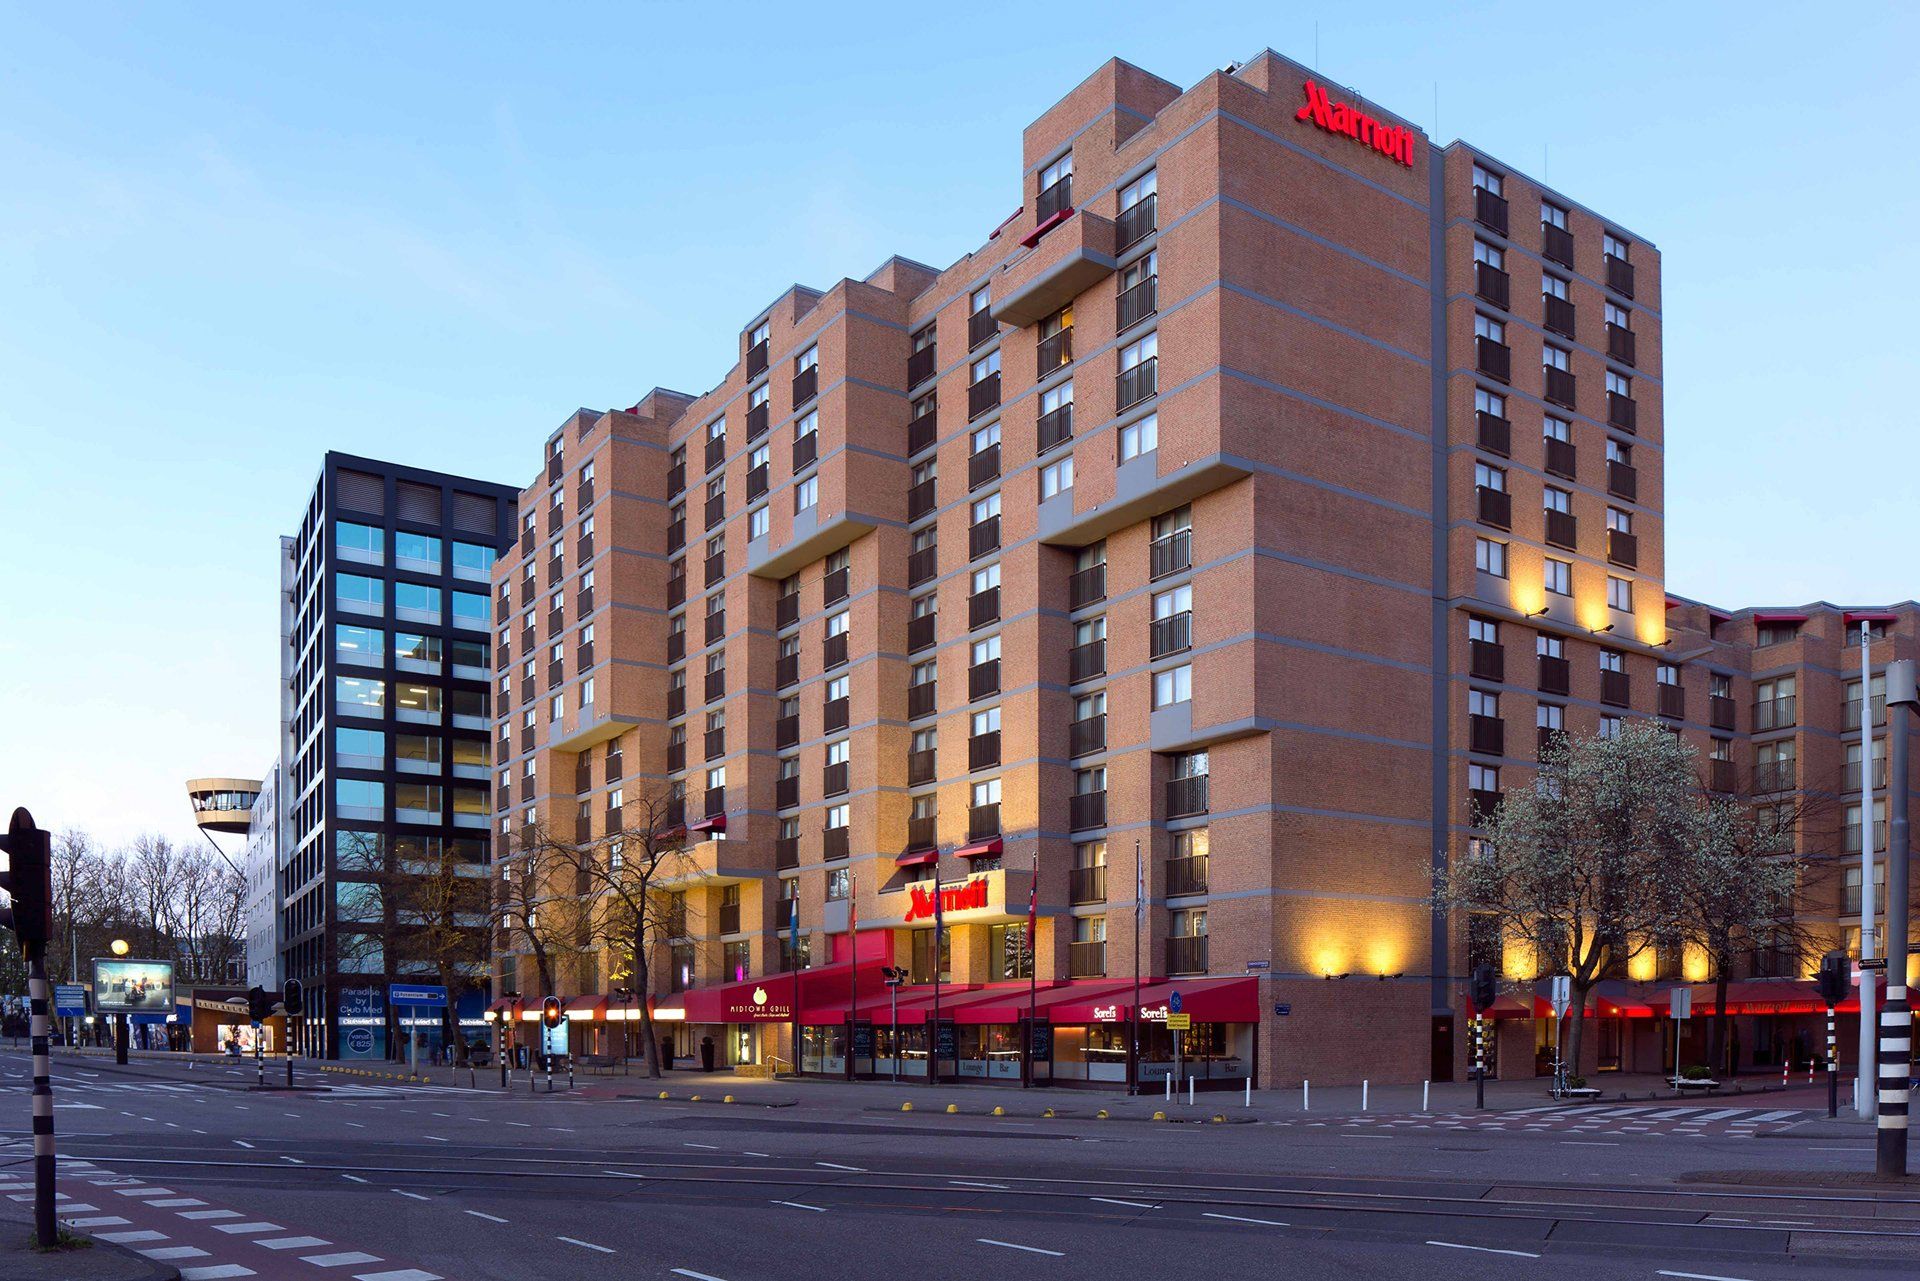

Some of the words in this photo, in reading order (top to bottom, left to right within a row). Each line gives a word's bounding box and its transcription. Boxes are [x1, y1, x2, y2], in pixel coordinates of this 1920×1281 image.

[1296, 79, 1414, 167] Marriott
[904, 878, 988, 922] Marriott
[341, 987, 380, 996] Paradise
[355, 997, 366, 1006] by
[340, 1005, 361, 1013] Club
[362, 1005, 383, 1013] Med
[730, 1005, 765, 1013] MIDTOWN
[769, 1005, 789, 1013] GRILL
[962, 1061, 983, 1075] Lounge
[1000, 1062, 1010, 1072] Bar
[1224, 1063, 1238, 1073] Bar
